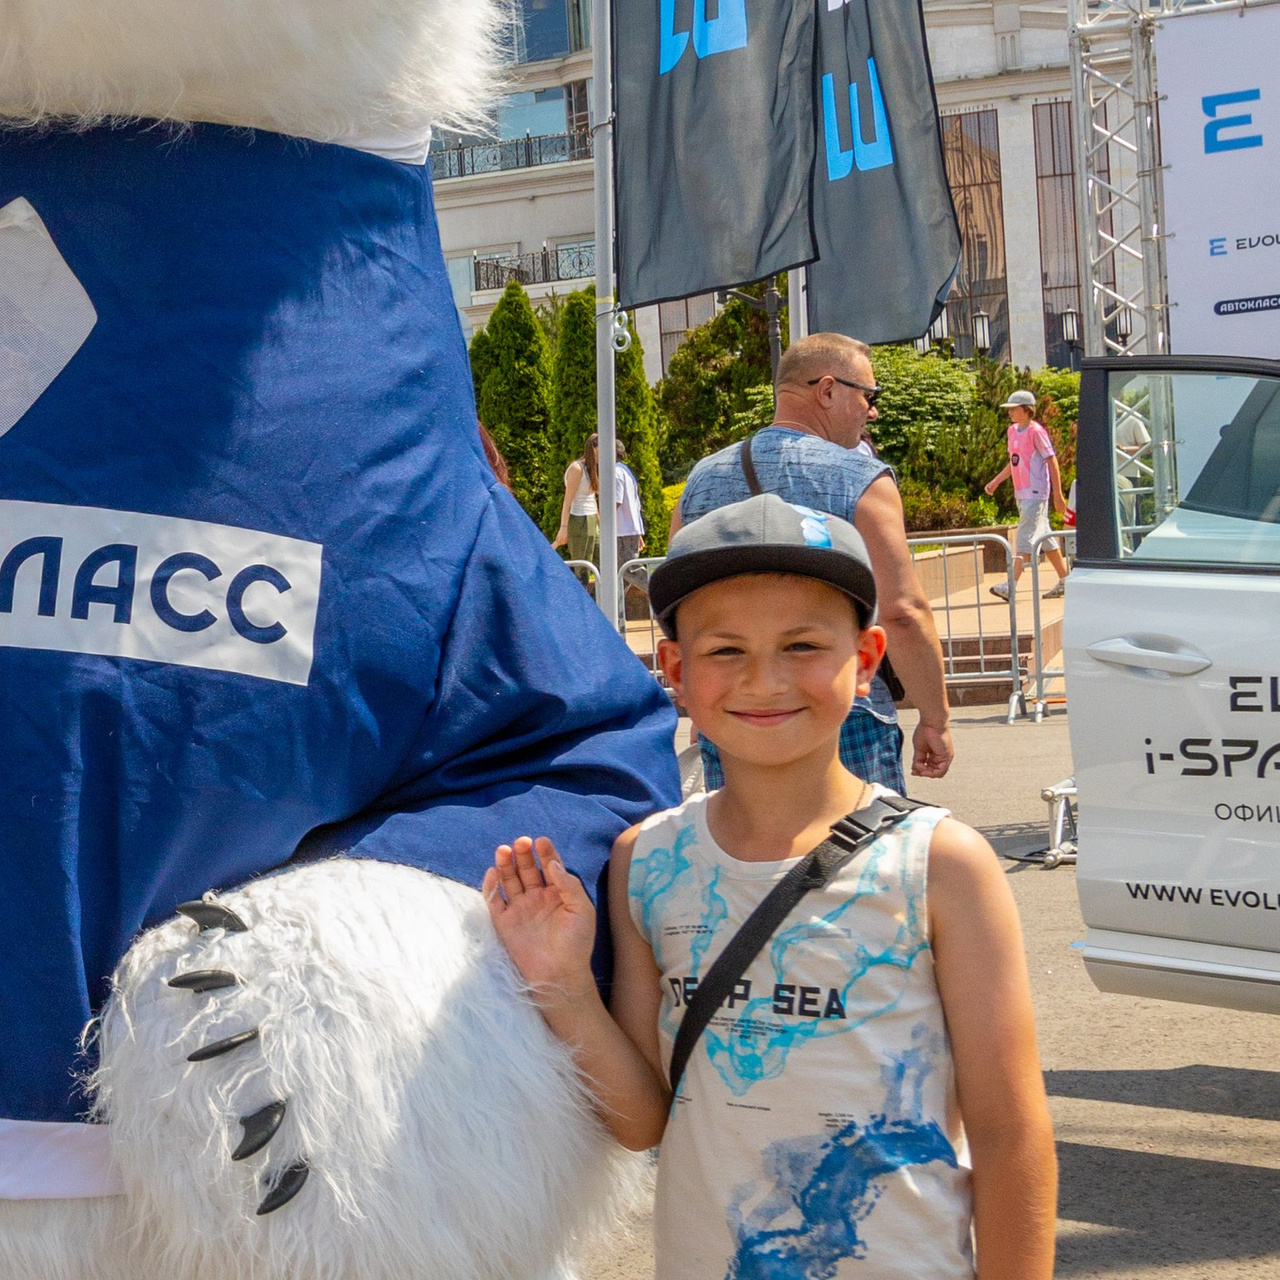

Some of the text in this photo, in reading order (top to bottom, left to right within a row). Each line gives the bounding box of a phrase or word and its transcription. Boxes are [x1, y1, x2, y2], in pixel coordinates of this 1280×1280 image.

[1220, 298, 1280, 313] АВТОКЛАС
[1214, 803, 1280, 824] ОФИ
[1126, 882, 1280, 911] WWW EVOL
[668, 976, 847, 1020] DEP SEA
